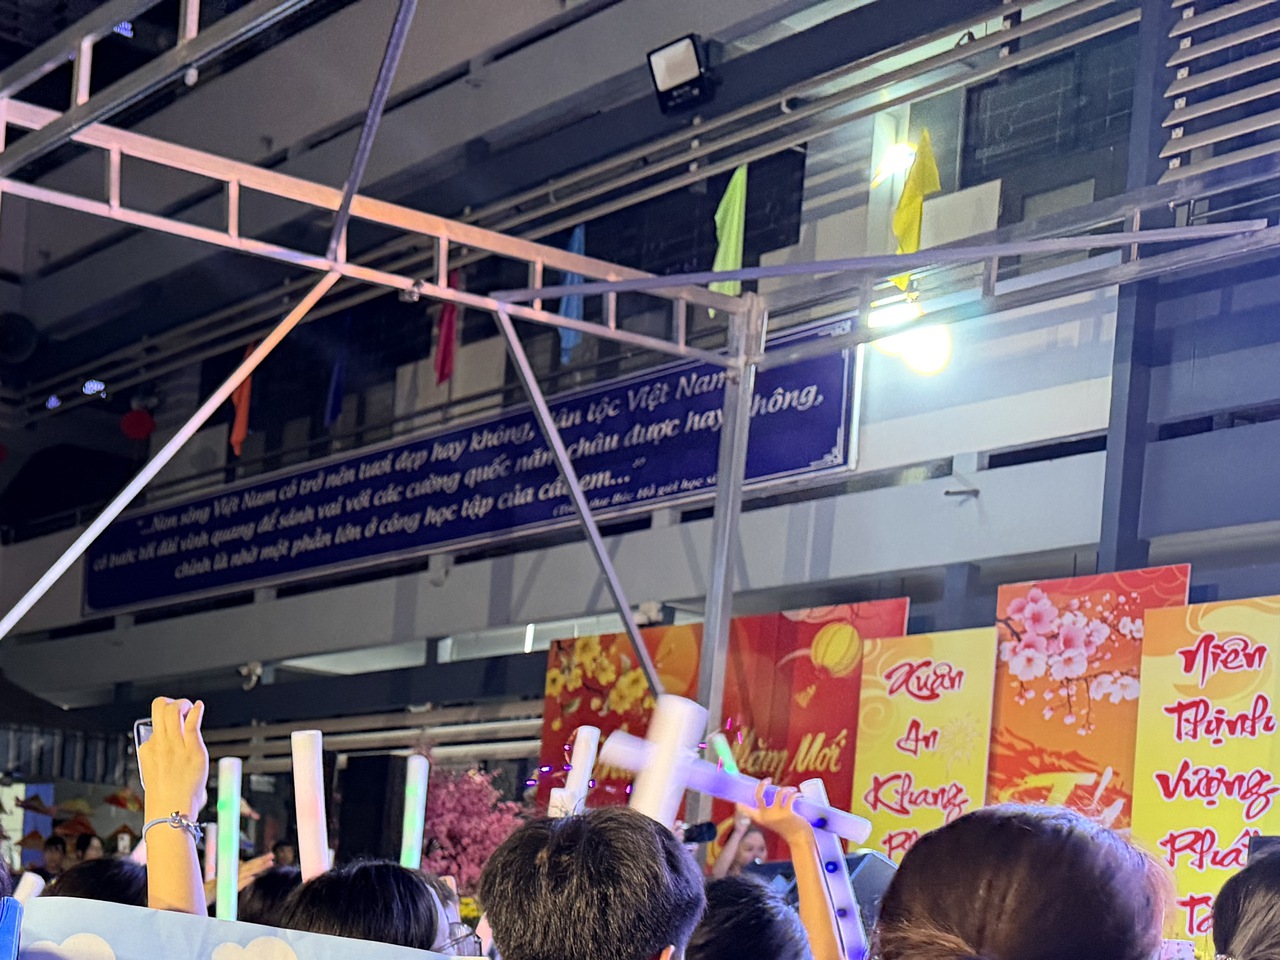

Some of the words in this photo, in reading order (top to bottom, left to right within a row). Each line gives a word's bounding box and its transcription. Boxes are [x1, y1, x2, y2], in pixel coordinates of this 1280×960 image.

[430, 439, 467, 462] hay
[586, 396, 622, 424] tộc
[626, 380, 670, 412] Việt
[463, 453, 512, 489] quốc
[623, 415, 680, 447] được
[683, 407, 724, 434] hay
[749, 384, 824, 417] hông,
[423, 503, 459, 528] học
[461, 494, 495, 520] tập
[497, 483, 536, 510] của
[883, 660, 965, 701] Xuân
[1178, 633, 1268, 687] Niên
[895, 718, 939, 757] An
[1163, 693, 1276, 745] Thịnh
[863, 772, 970, 826] Khang
[1155, 759, 1280, 821] Vượng
